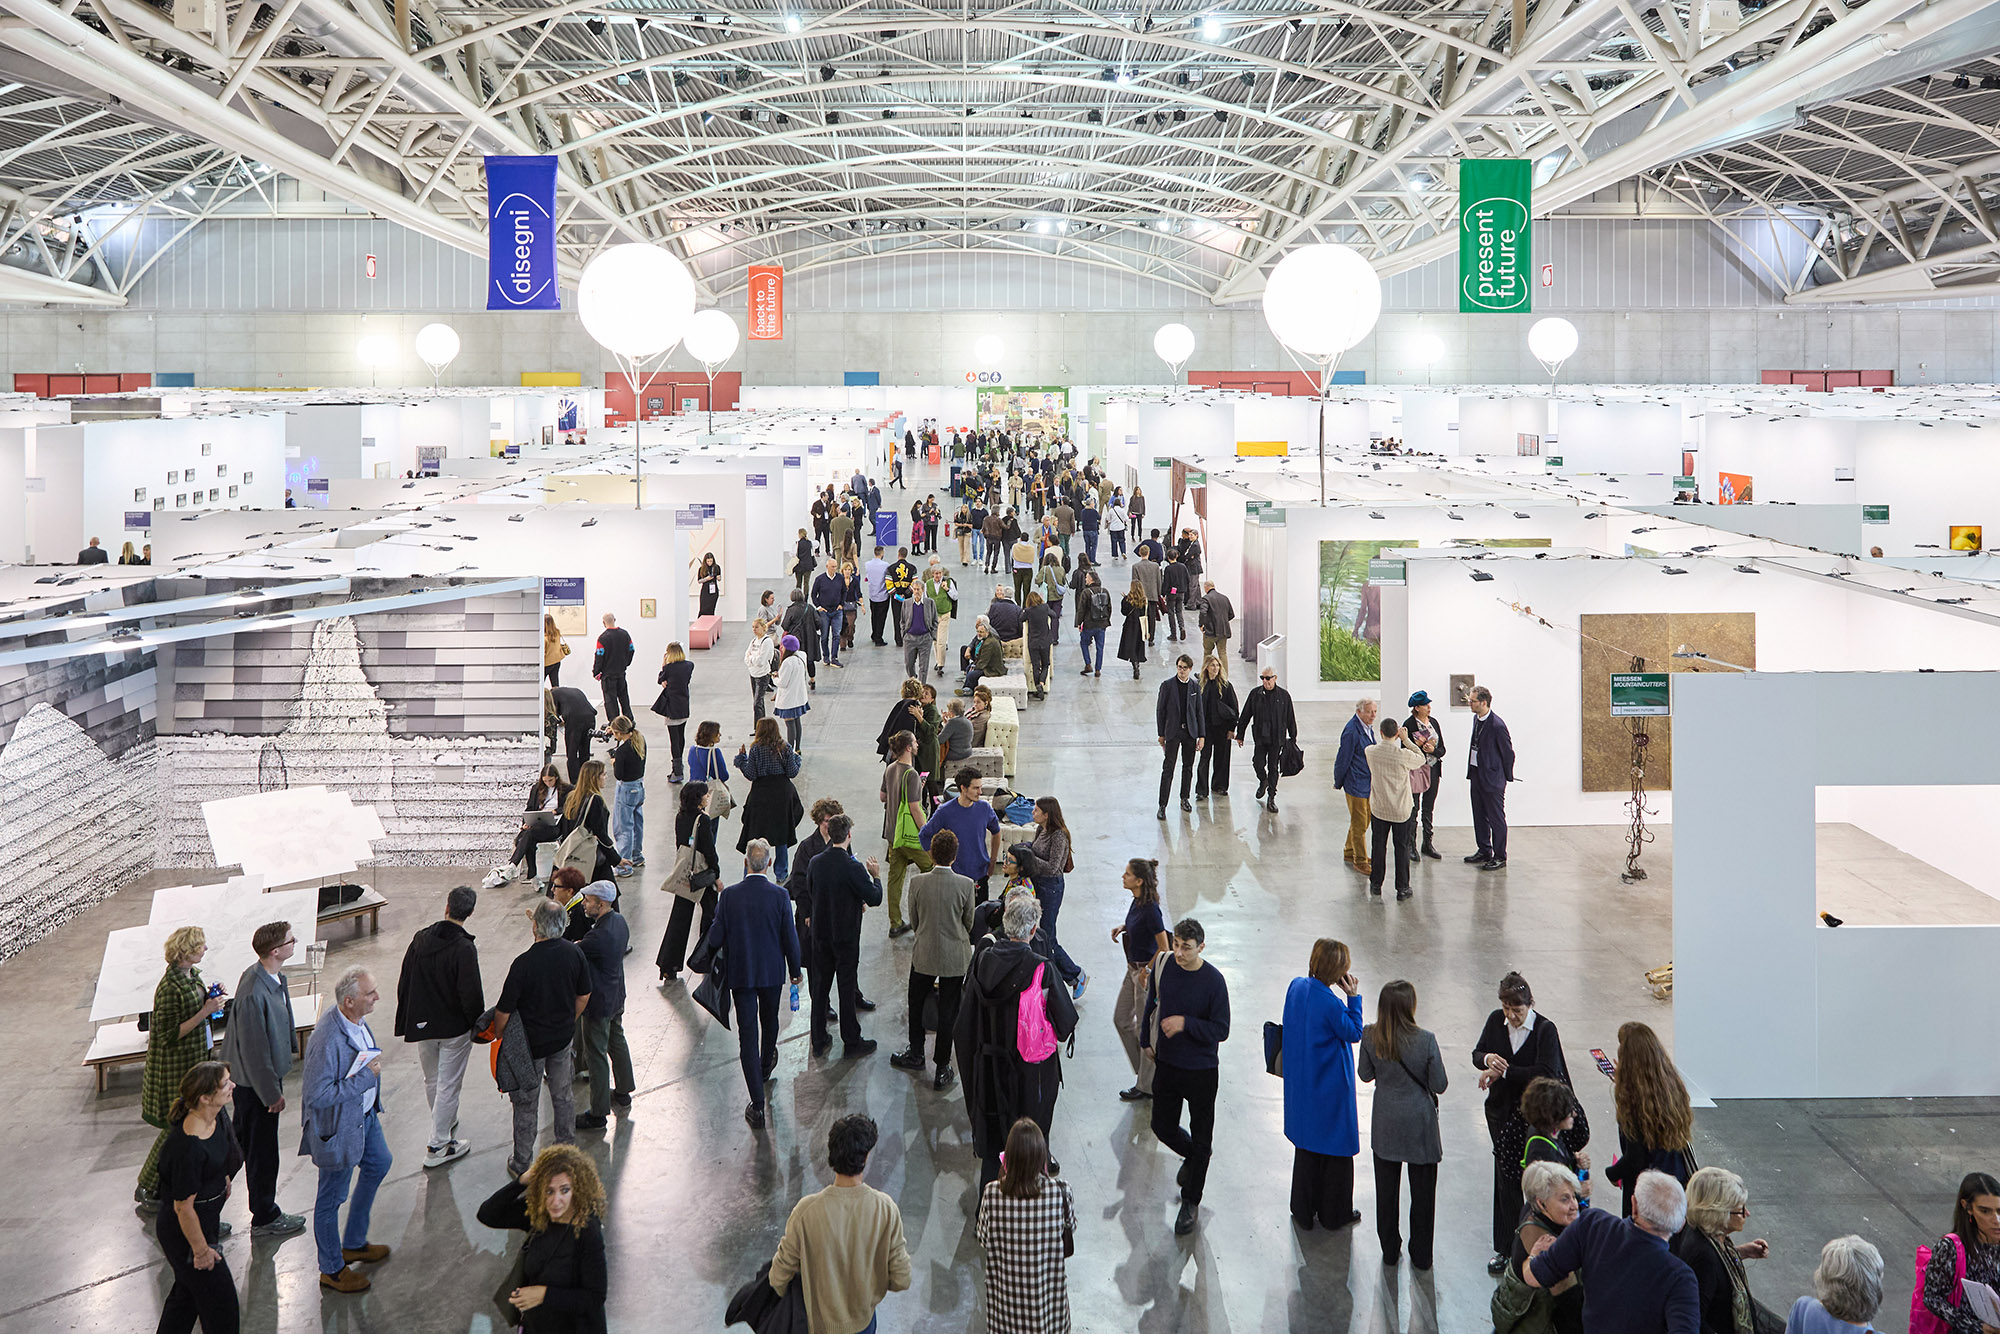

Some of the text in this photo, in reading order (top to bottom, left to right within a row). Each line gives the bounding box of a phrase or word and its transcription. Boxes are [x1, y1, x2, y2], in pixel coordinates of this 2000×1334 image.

[510, 210, 534, 294] disegni
[1476, 209, 1497, 297] present
[1496, 229, 1516, 298] future
[756, 290, 765, 332] back to
[766, 278, 776, 332] the future
